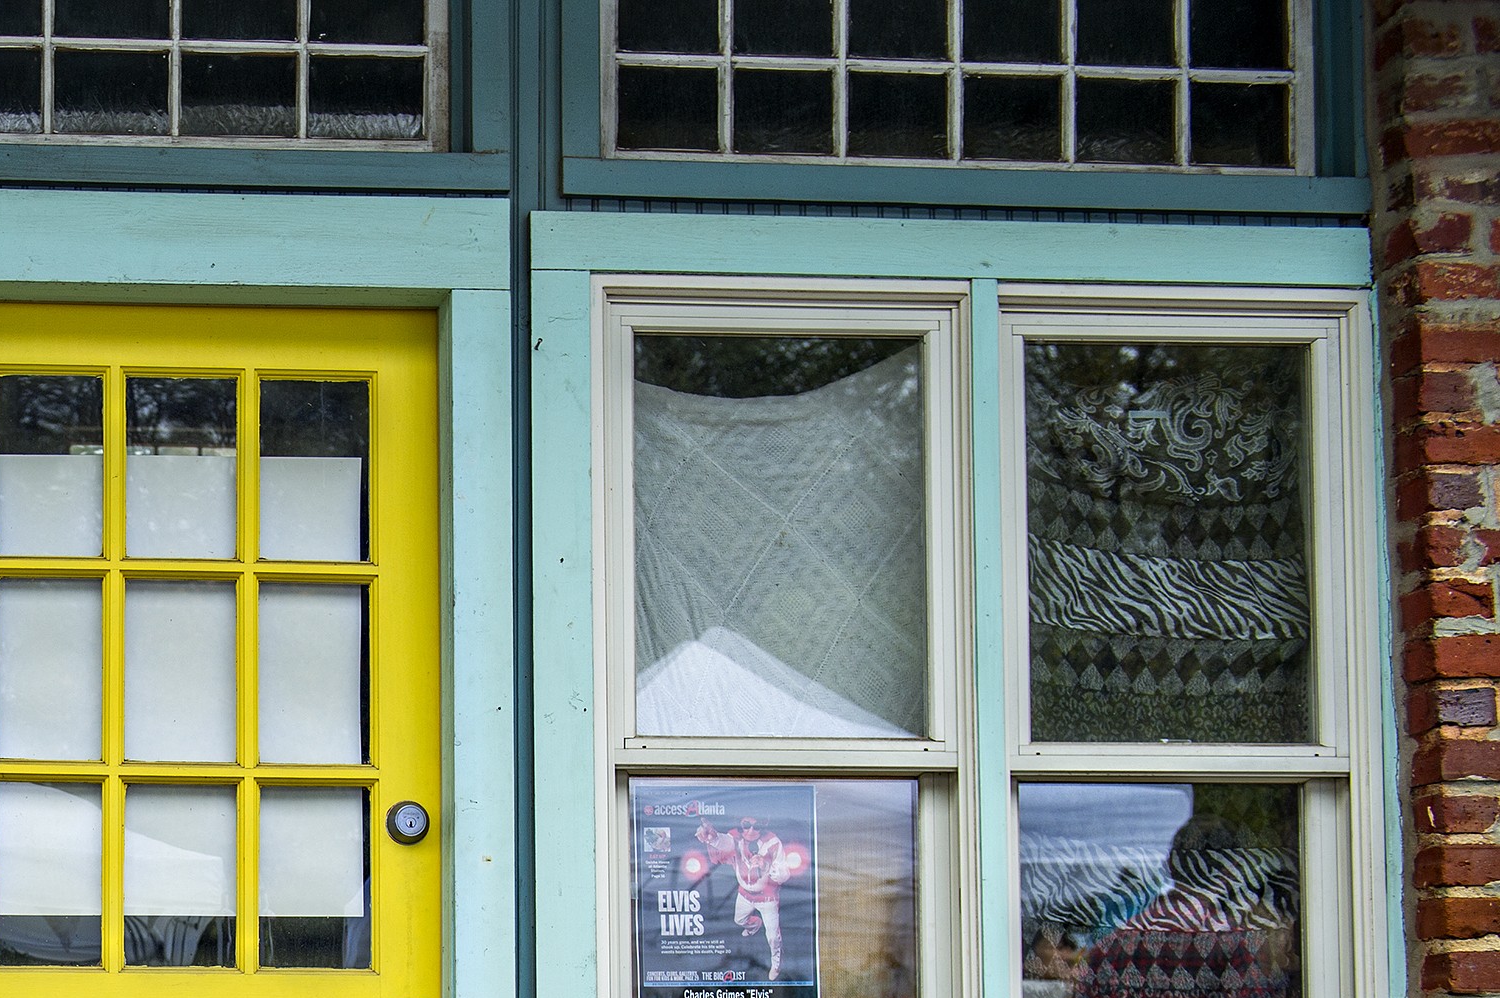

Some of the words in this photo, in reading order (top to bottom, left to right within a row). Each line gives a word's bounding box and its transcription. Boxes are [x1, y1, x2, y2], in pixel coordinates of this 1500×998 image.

[658, 890, 700, 912] ELVIS
[660, 914, 705, 936] LIVES
[702, 971, 713, 981] THE
